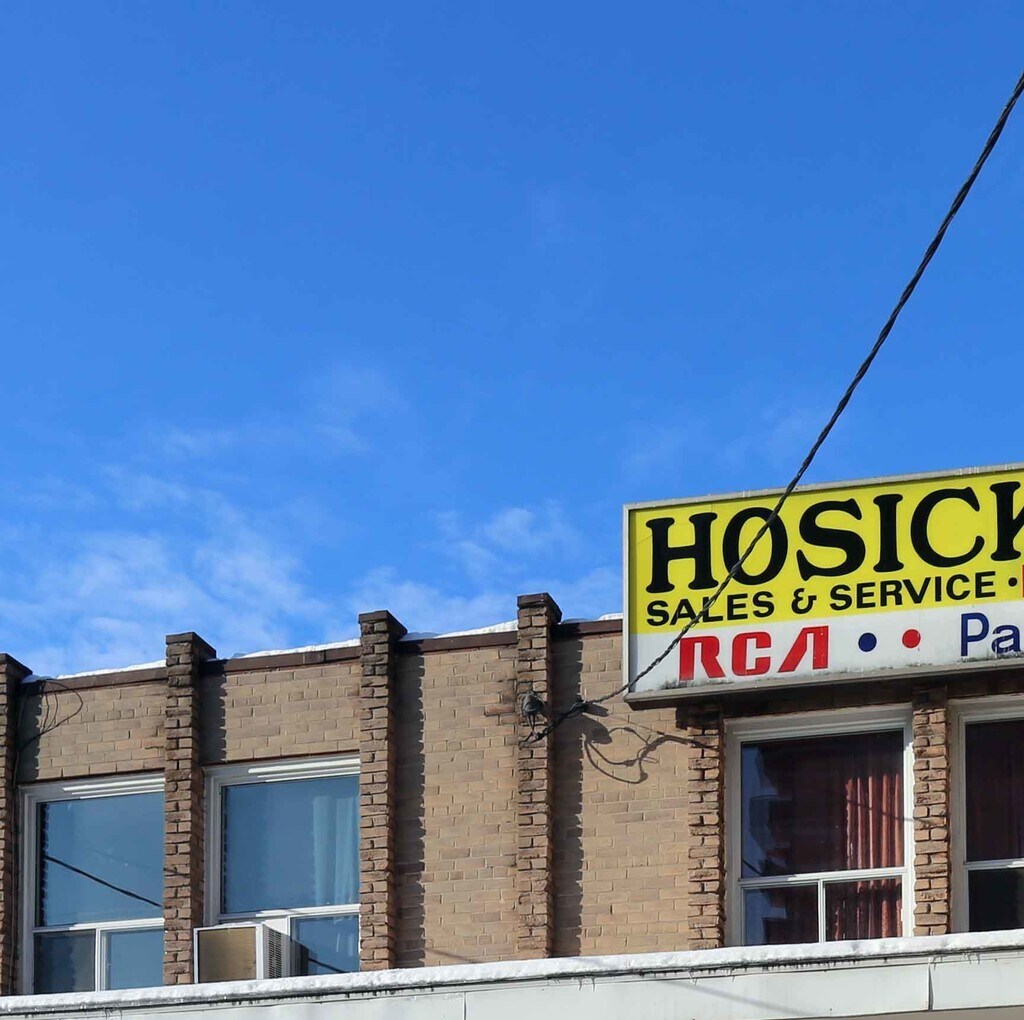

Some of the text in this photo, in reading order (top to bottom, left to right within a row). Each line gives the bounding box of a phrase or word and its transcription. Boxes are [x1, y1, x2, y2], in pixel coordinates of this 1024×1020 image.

[646, 572, 995, 627] SALES & SERVICE
[678, 625, 829, 682] RCA
